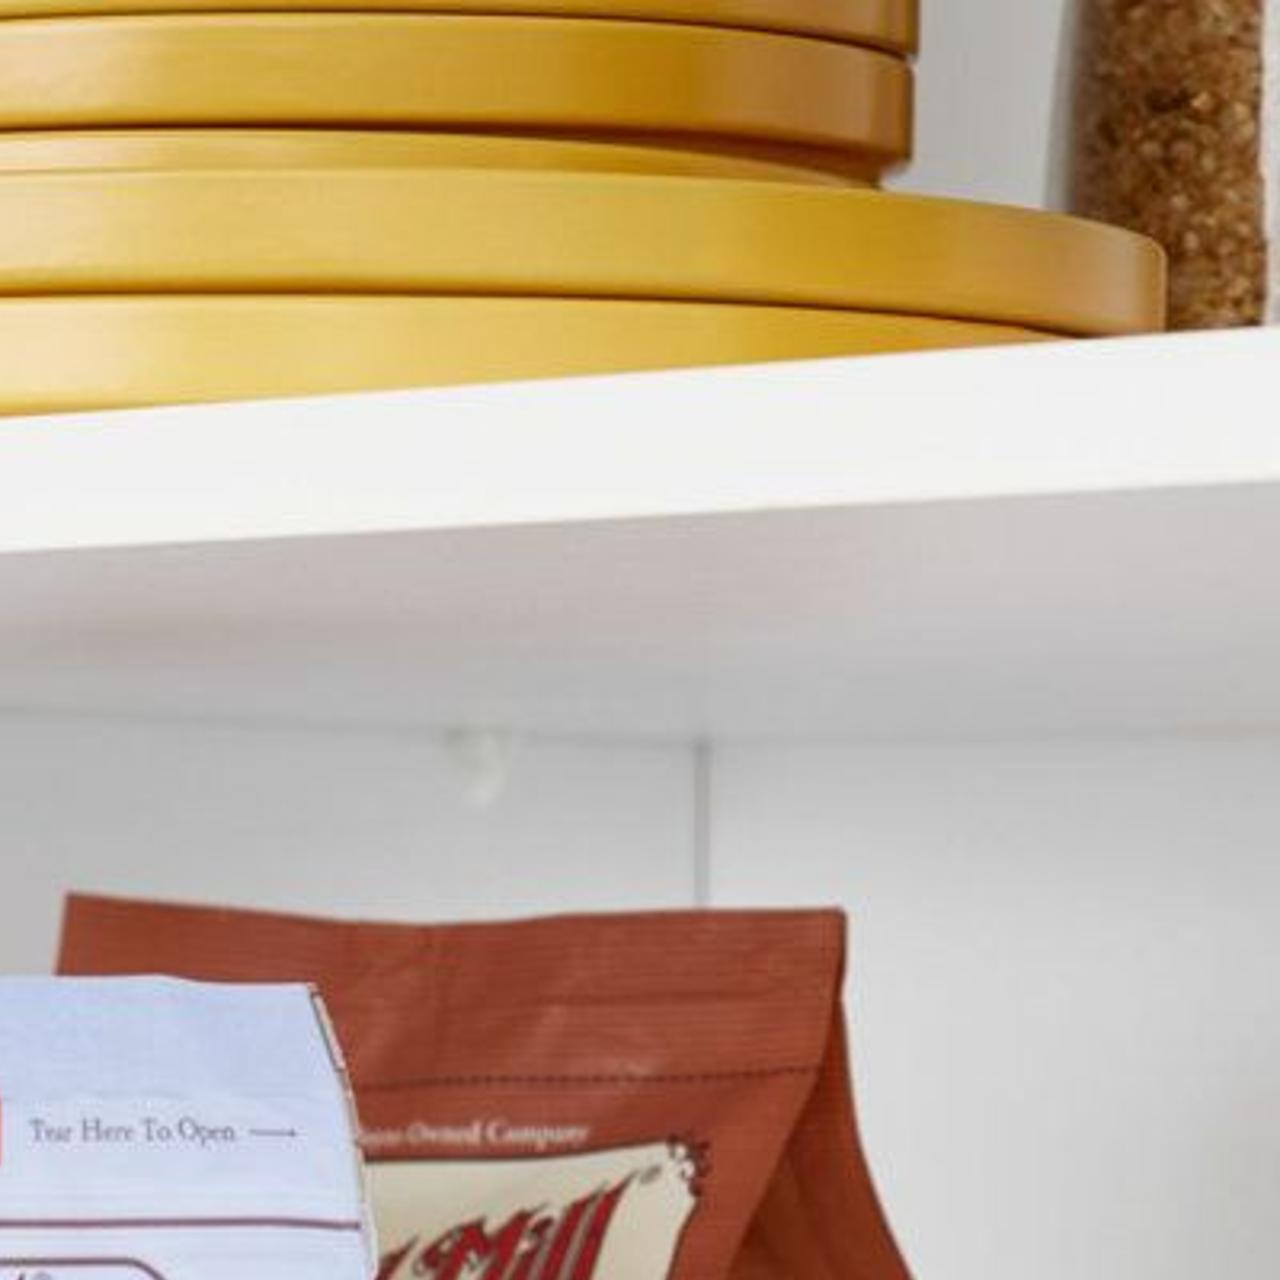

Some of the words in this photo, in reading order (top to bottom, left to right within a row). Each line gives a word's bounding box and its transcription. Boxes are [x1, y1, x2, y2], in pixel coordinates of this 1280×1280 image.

[31, 1118, 72, 1144] Tear
[81, 1118, 134, 1144] Here
[144, 1118, 172, 1143] To
[179, 1119, 237, 1150] Open
